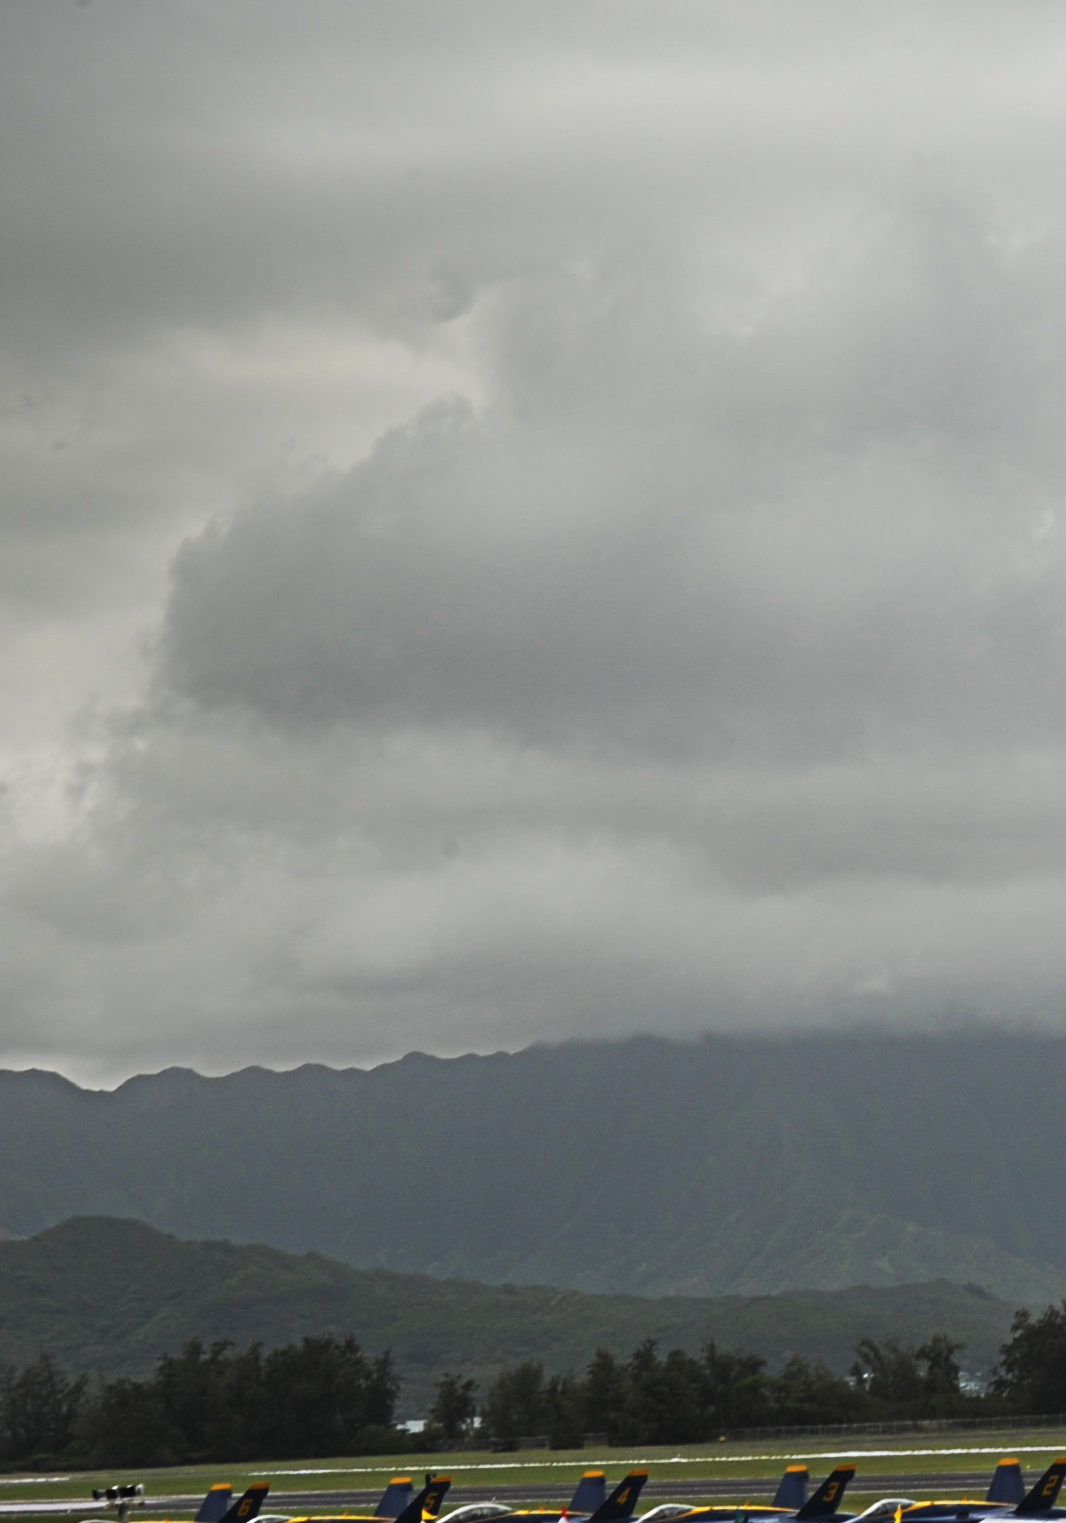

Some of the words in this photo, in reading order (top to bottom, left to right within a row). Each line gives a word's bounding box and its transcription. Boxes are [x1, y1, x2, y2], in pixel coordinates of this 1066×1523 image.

[822, 1482, 839, 1501] 3
[1042, 1475, 1059, 1496] 2
[425, 1492, 439, 1510] 5
[617, 1487, 631, 1505] 4
[237, 1499, 253, 1516] 6
